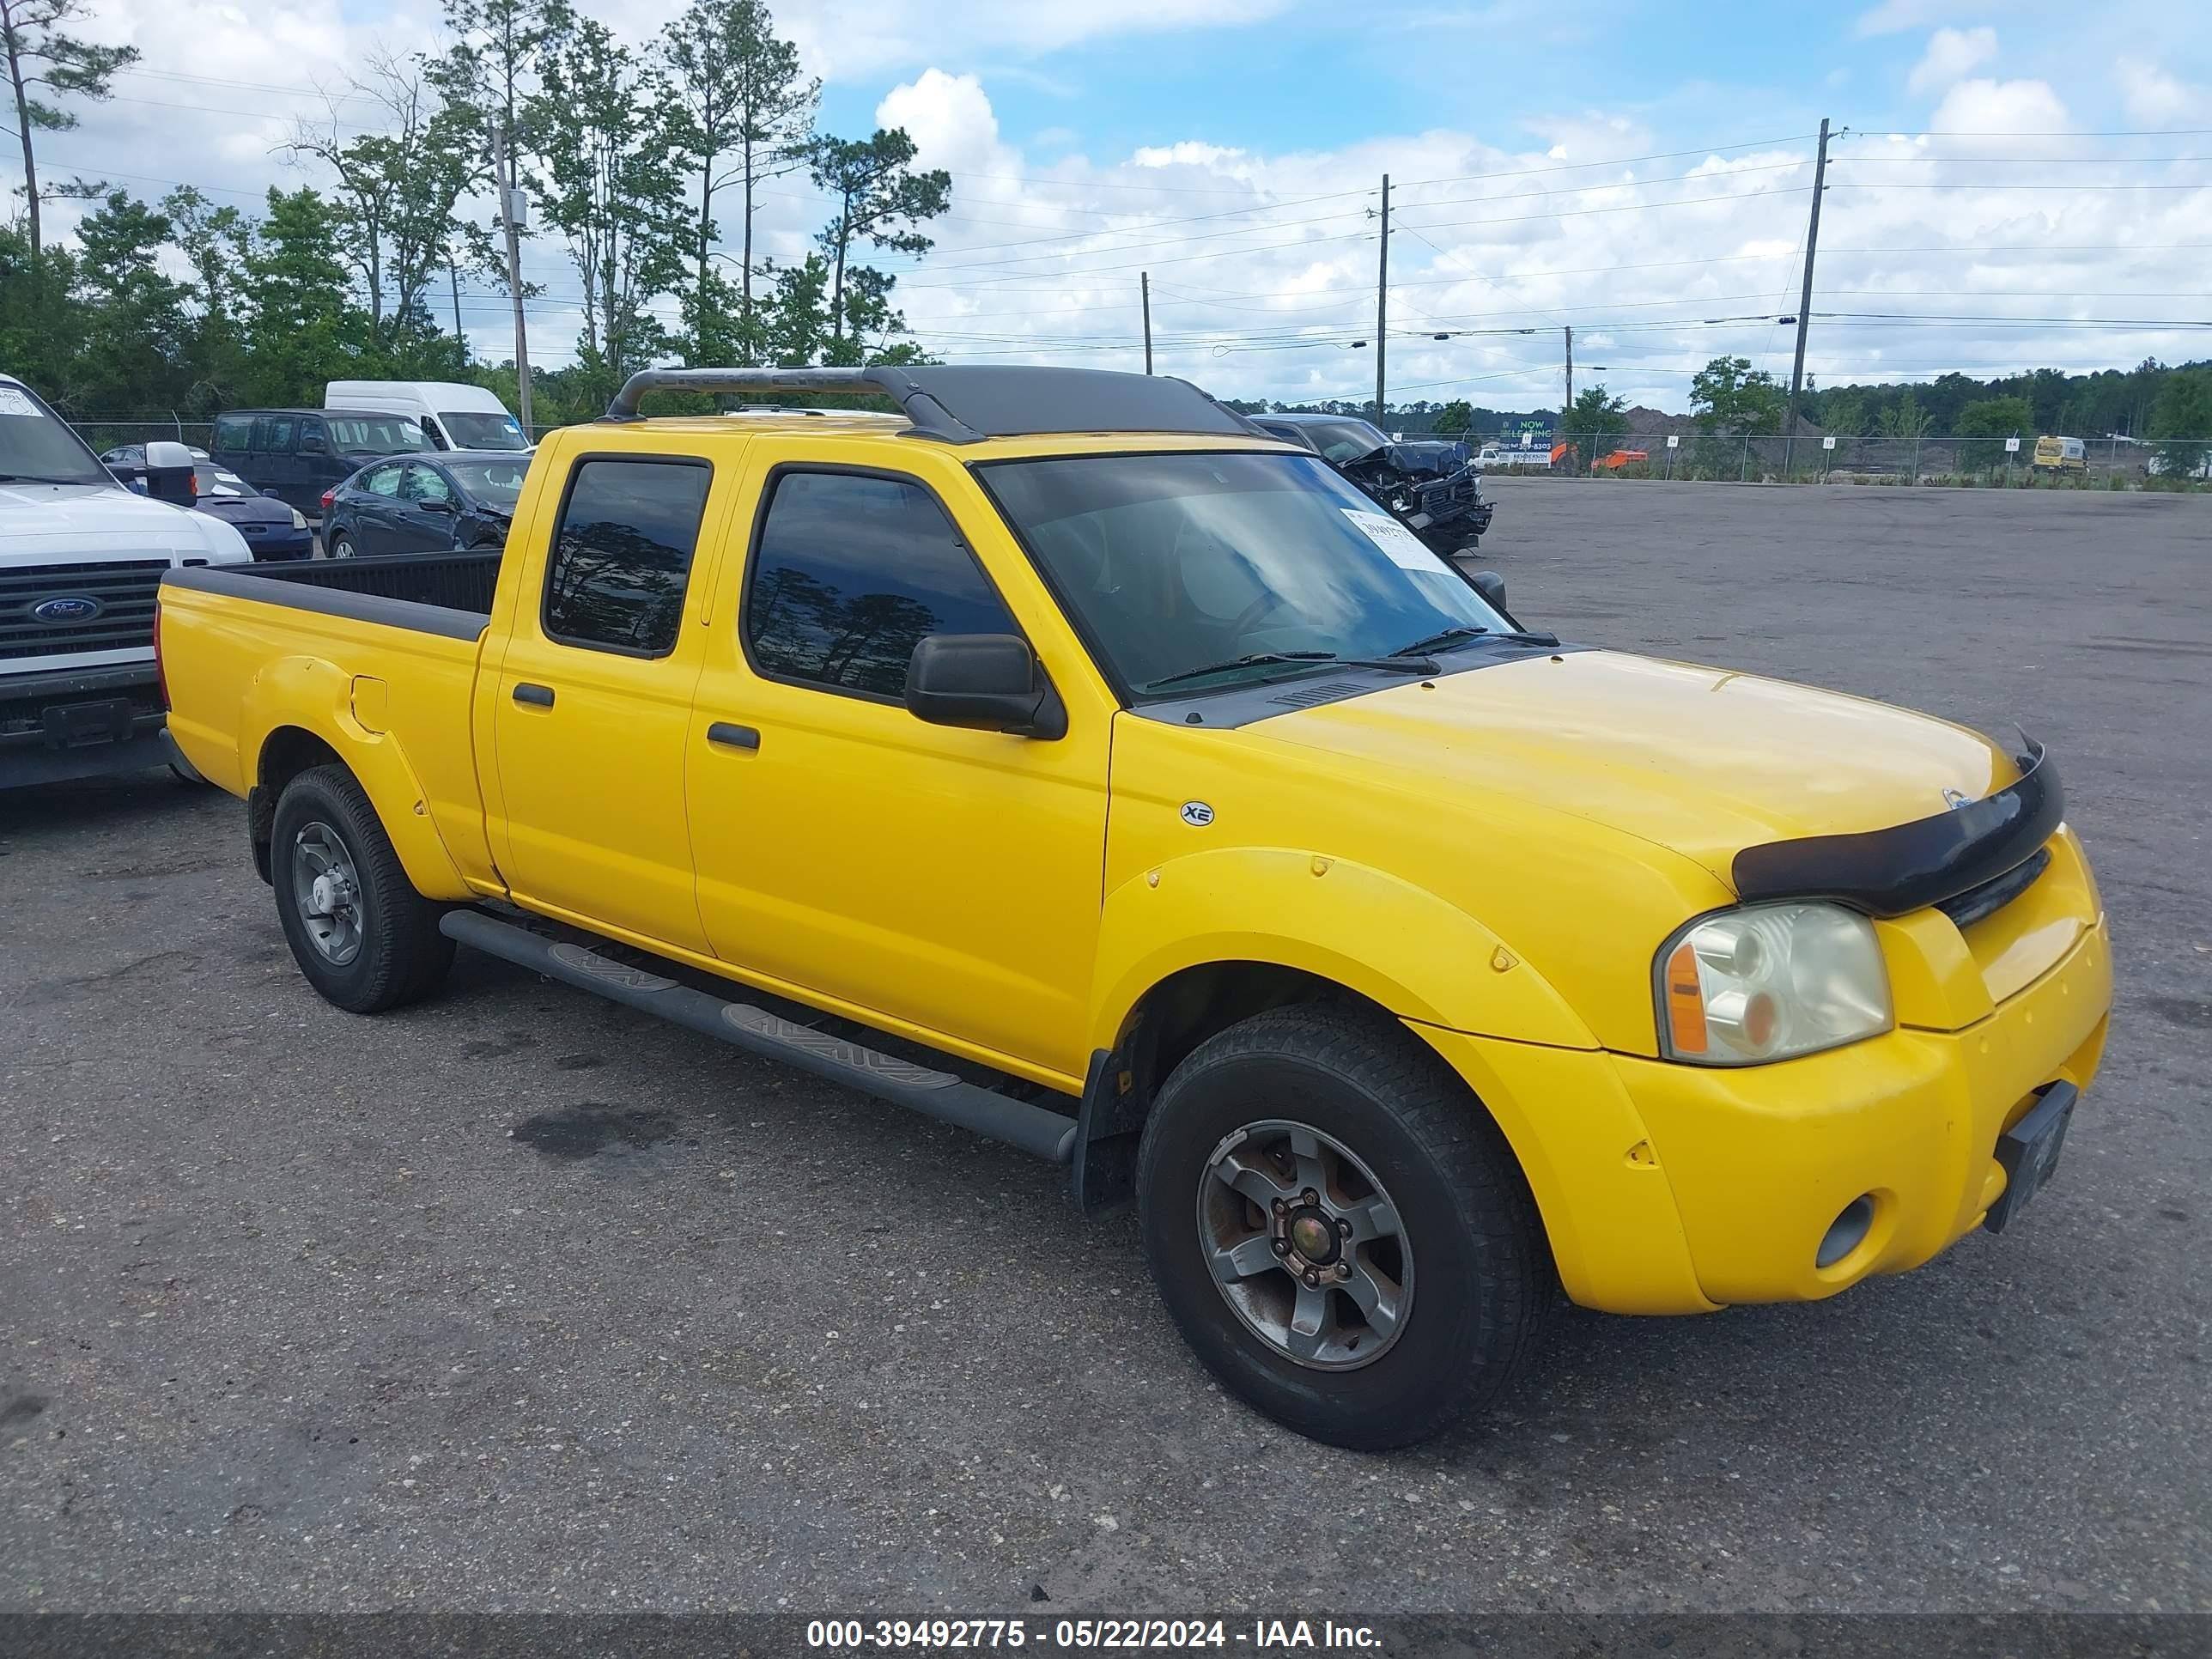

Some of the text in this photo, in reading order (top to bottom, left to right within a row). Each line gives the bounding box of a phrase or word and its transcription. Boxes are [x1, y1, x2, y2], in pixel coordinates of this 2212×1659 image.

[1520, 420, 1545, 429] NOW
[51, 602, 85, 616] Ford
[1183, 805, 1212, 823] XE
